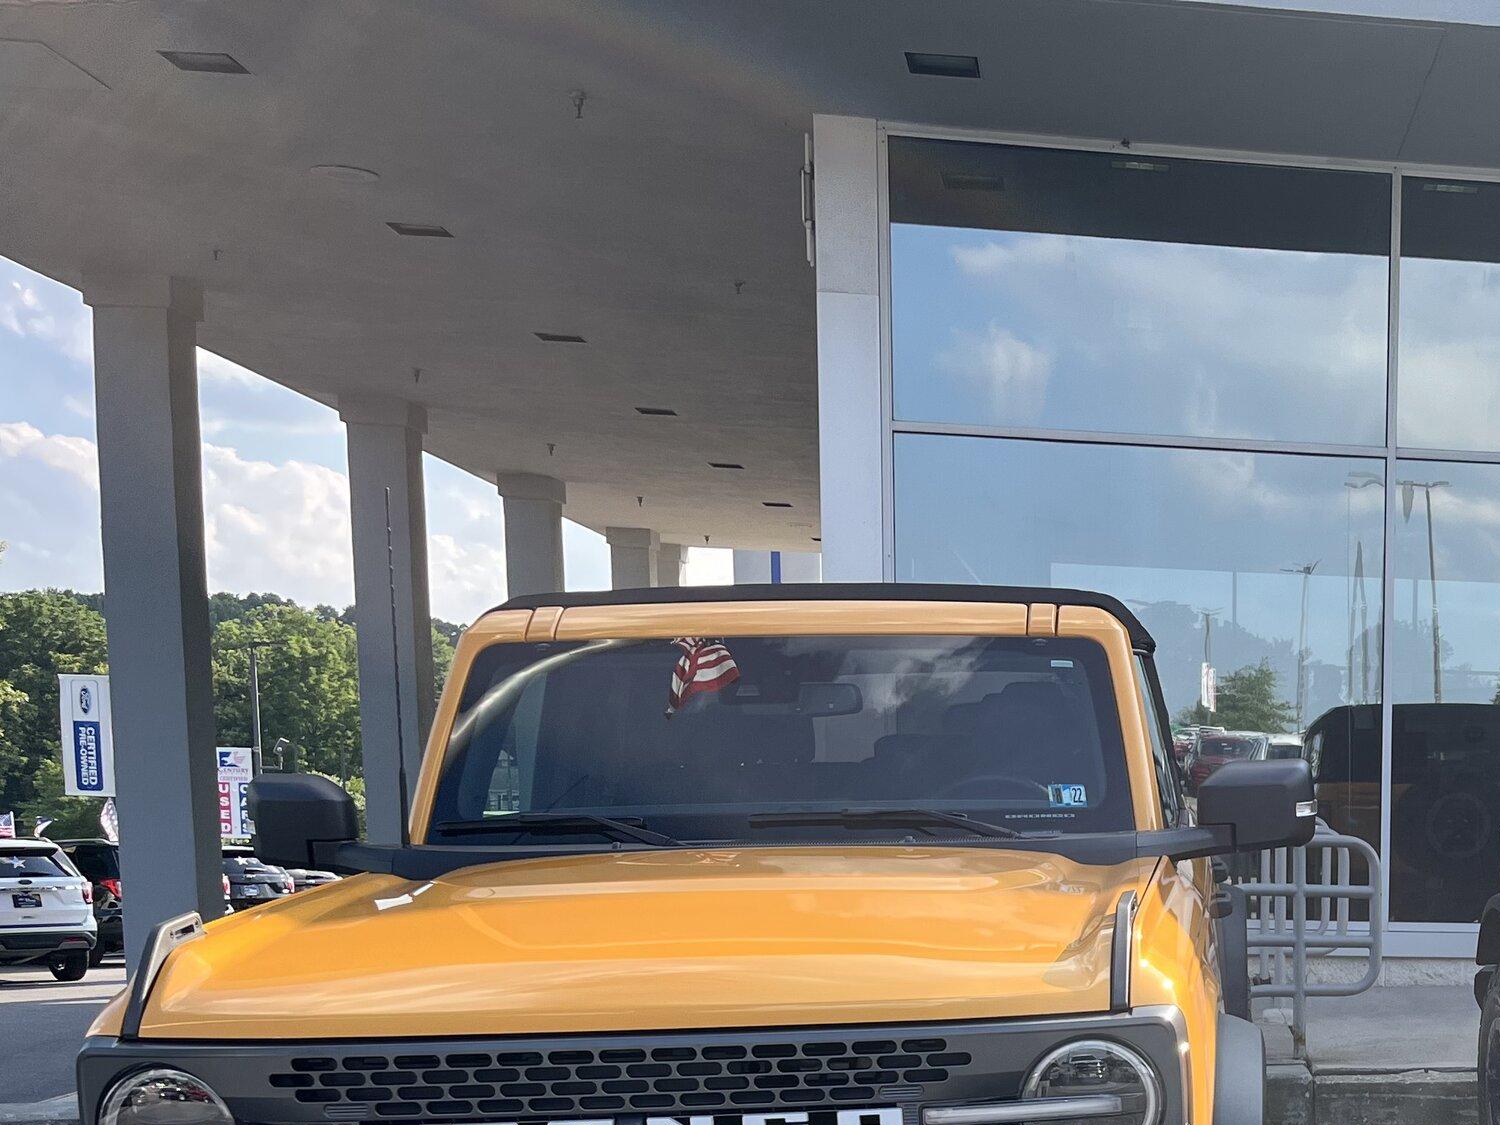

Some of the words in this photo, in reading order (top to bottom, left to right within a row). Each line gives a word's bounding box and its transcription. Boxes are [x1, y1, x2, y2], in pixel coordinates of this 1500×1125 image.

[79, 726, 89, 786] PRE-OWNED
[86, 726, 98, 786] CERTIFIED
[218, 783, 232, 833] USED
[1071, 787, 1084, 803] 22
